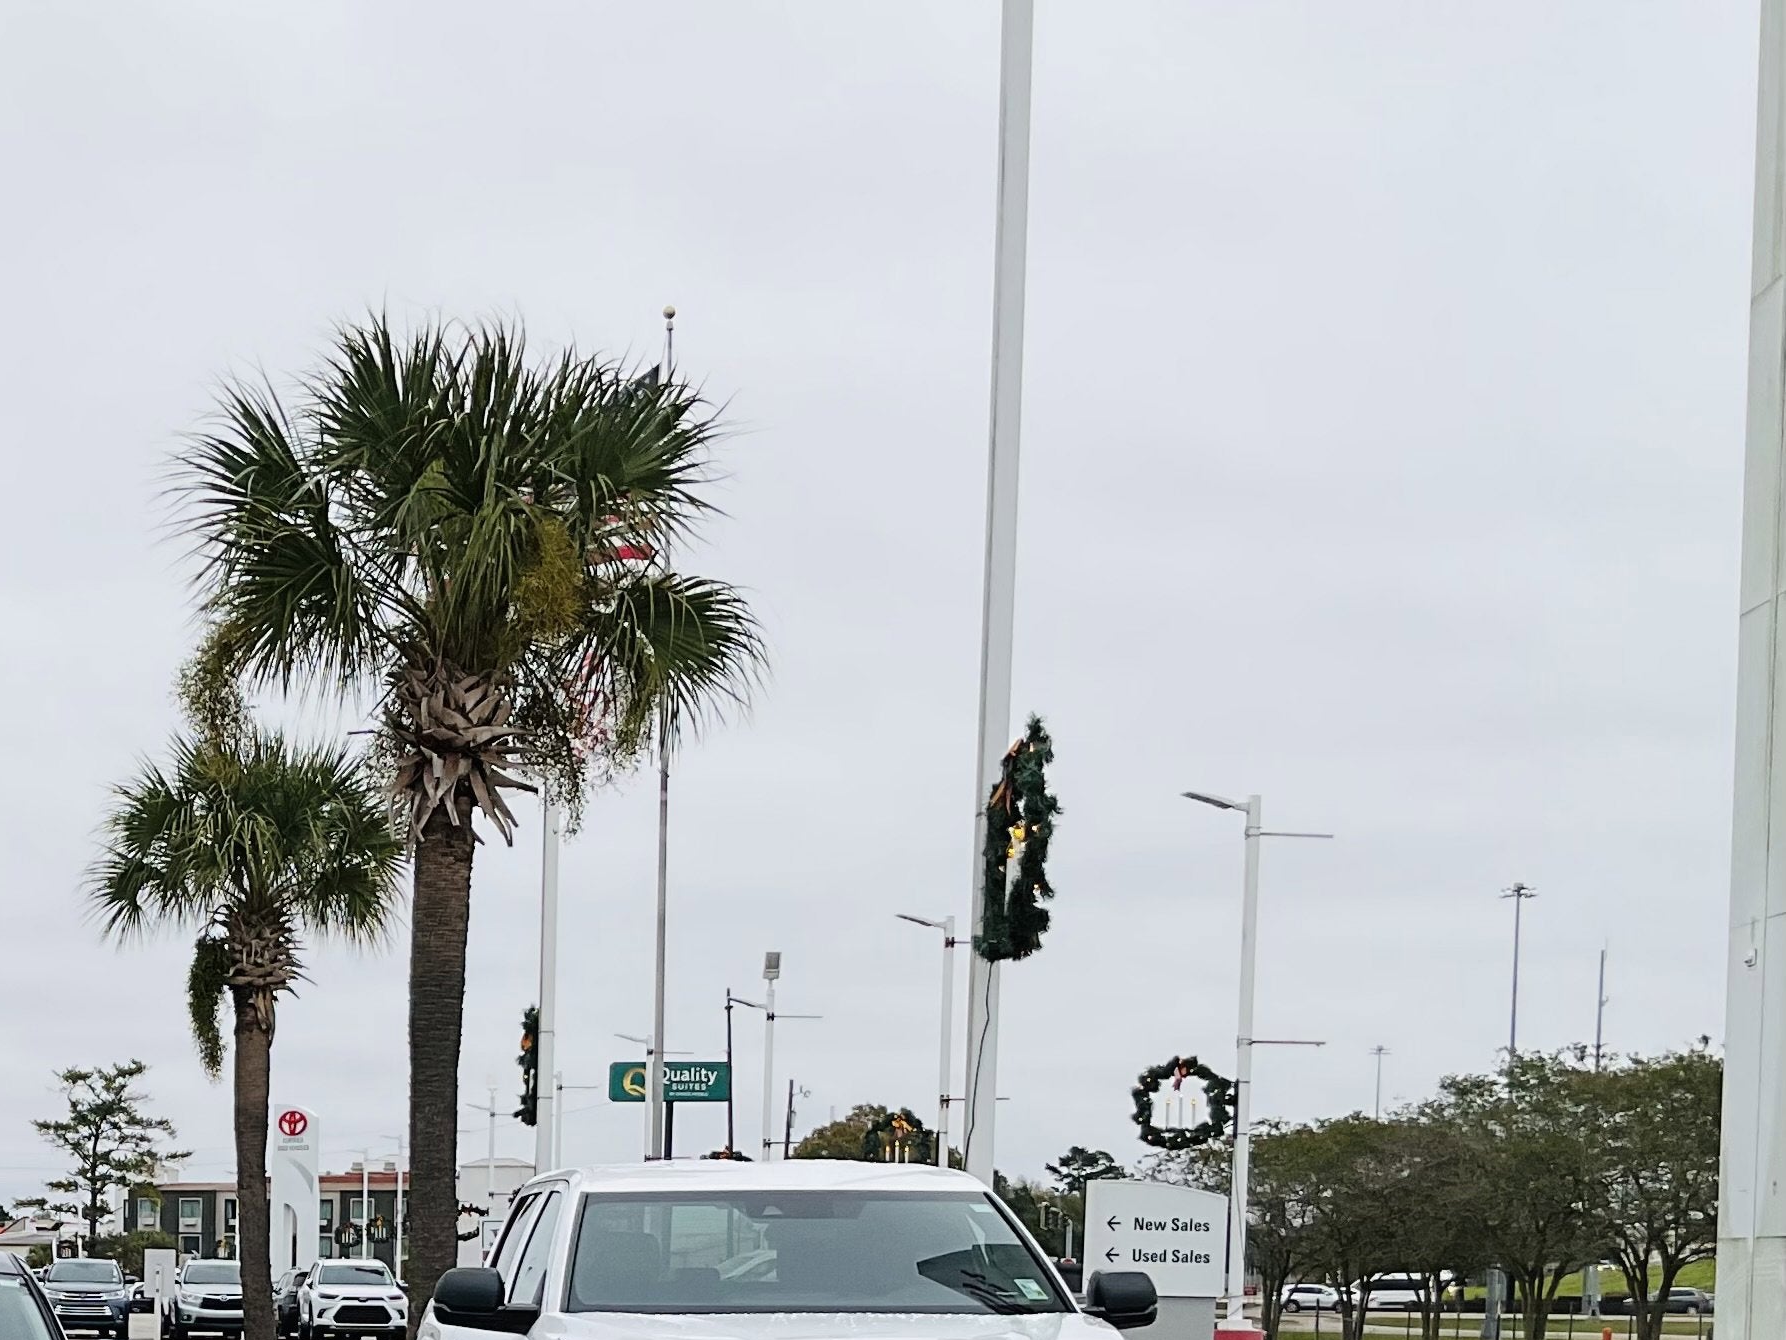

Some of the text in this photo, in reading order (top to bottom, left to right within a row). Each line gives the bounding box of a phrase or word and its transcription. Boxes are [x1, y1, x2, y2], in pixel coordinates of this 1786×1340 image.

[662, 1067, 718, 1086] Quality
[671, 1083, 707, 1091] SUITES
[1134, 1217, 1210, 1232] New Sales
[1132, 1248, 1210, 1264] Used Sales
